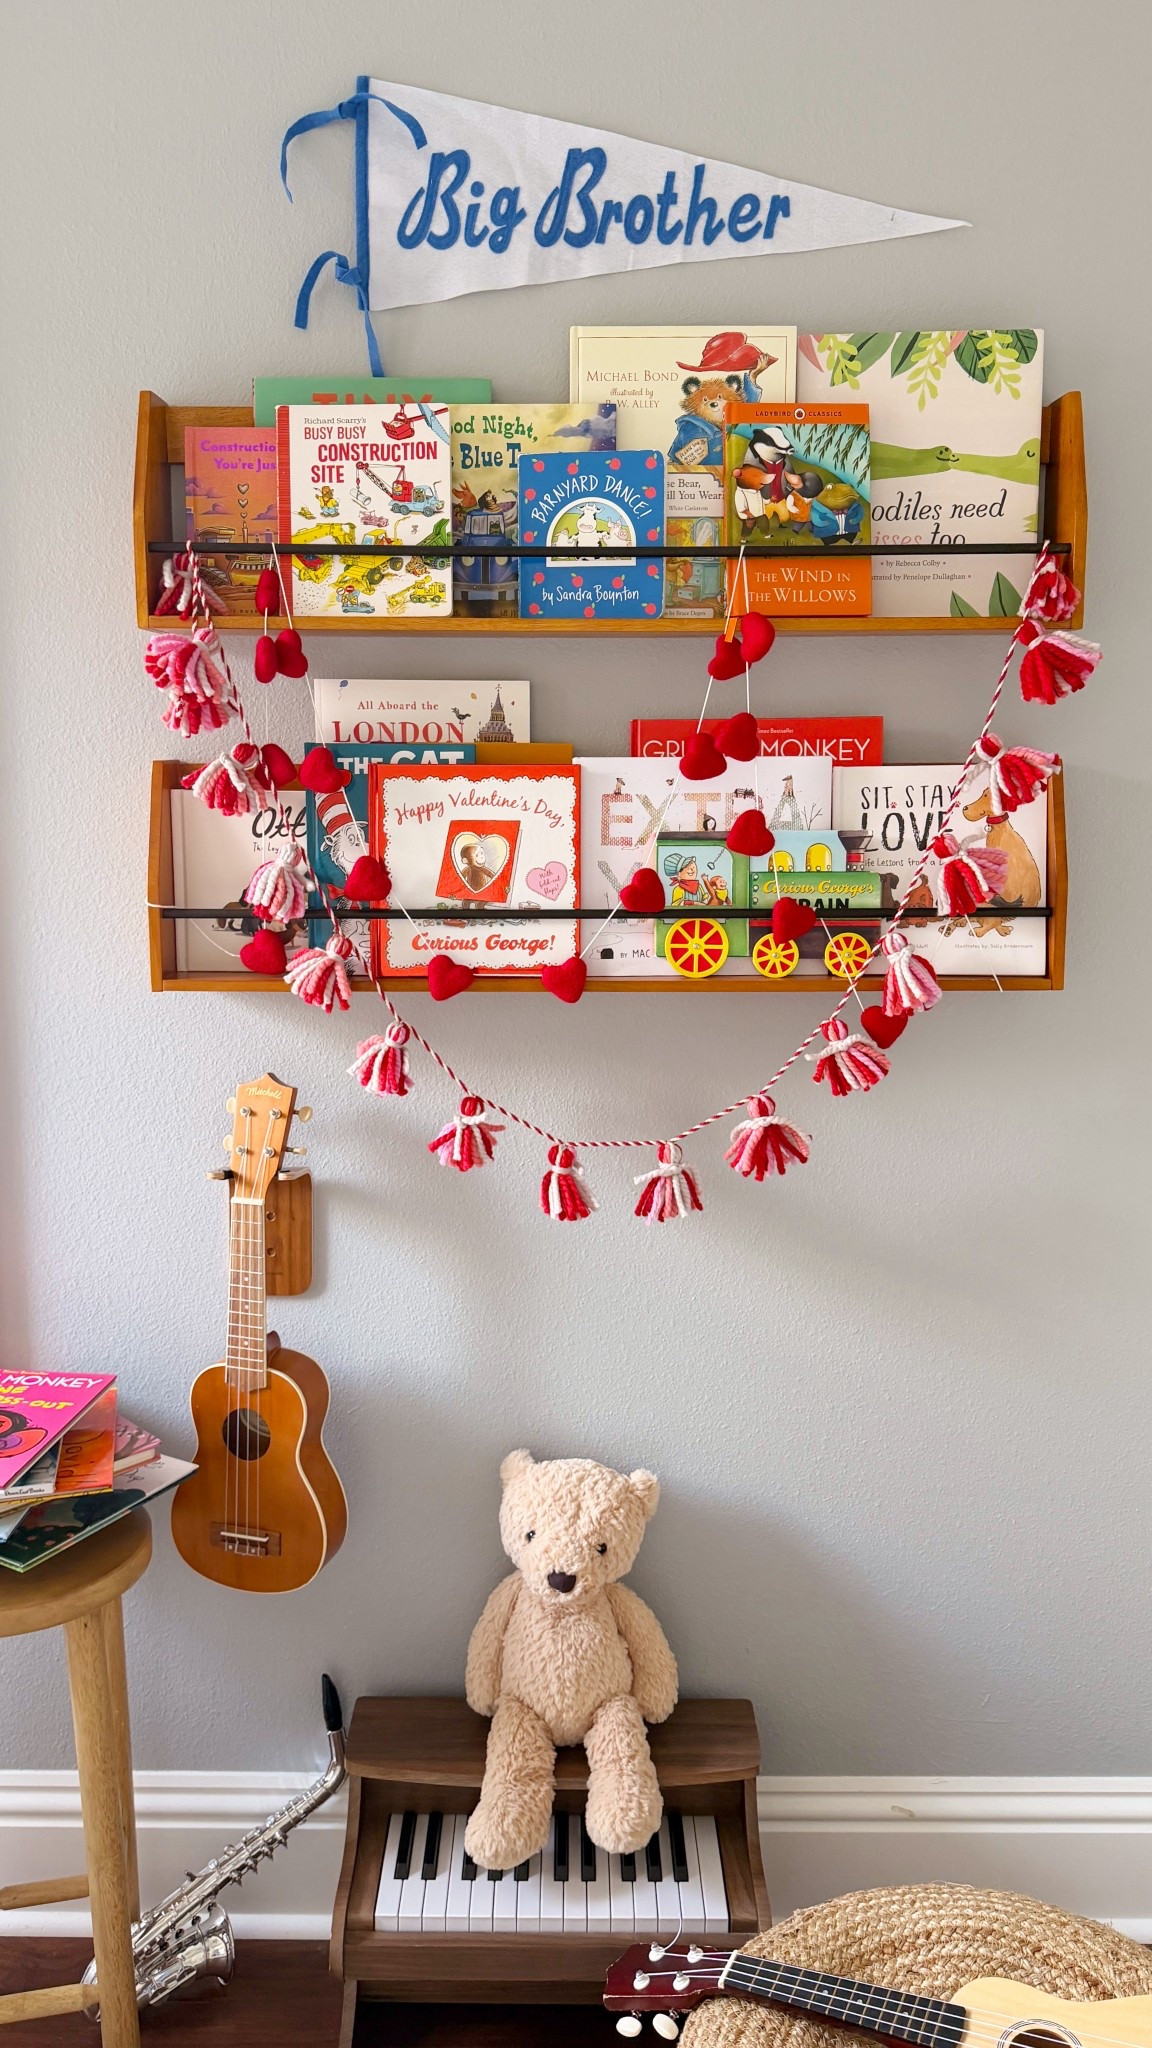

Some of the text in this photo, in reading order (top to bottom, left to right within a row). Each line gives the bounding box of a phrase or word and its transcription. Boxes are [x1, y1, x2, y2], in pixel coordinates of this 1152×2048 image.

[396, 146, 791, 254] Big Brother
[587, 370, 679, 382] MICHAEL BOND
[610, 388, 654, 399] illustrated by
[632, 399, 660, 408] ALLEY
[304, 417, 367, 425] Richard Scarry's
[482, 415, 538, 442] Night,
[304, 426, 367, 440] BUSY BUSY
[318, 441, 438, 462] CONSTRUCTION
[460, 443, 504, 469] Blue
[214, 458, 254, 470] You're
[311, 465, 345, 483] SITE
[678, 478, 701, 488] Bear,
[531, 474, 653, 524] BARNYARD DANCE!
[679, 490, 696, 500] You
[871, 488, 1008, 521] odiles need
[885, 560, 894, 568] by
[922, 559, 941, 568] Colby
[754, 567, 850, 583] THE WIND IN
[903, 573, 931, 581] Penelope
[542, 584, 640, 607] by Sandra Boynton
[748, 587, 857, 603] THE WILLOWS
[357, 701, 439, 710] All Aboard the
[331, 720, 465, 743] LONDON
[760, 738, 871, 761] MONKEY
[860, 784, 957, 809] SIT STAY
[394, 788, 566, 828] Happy Valentine's Day,
[877, 857, 904, 867] Lessons
[761, 879, 874, 898] Curious George's
[411, 931, 556, 957] Curious George!
[632, 949, 650, 958] MAC
[246, 1086, 283, 1100] Mitchell
[1, 1374, 103, 1389] MONKEY
